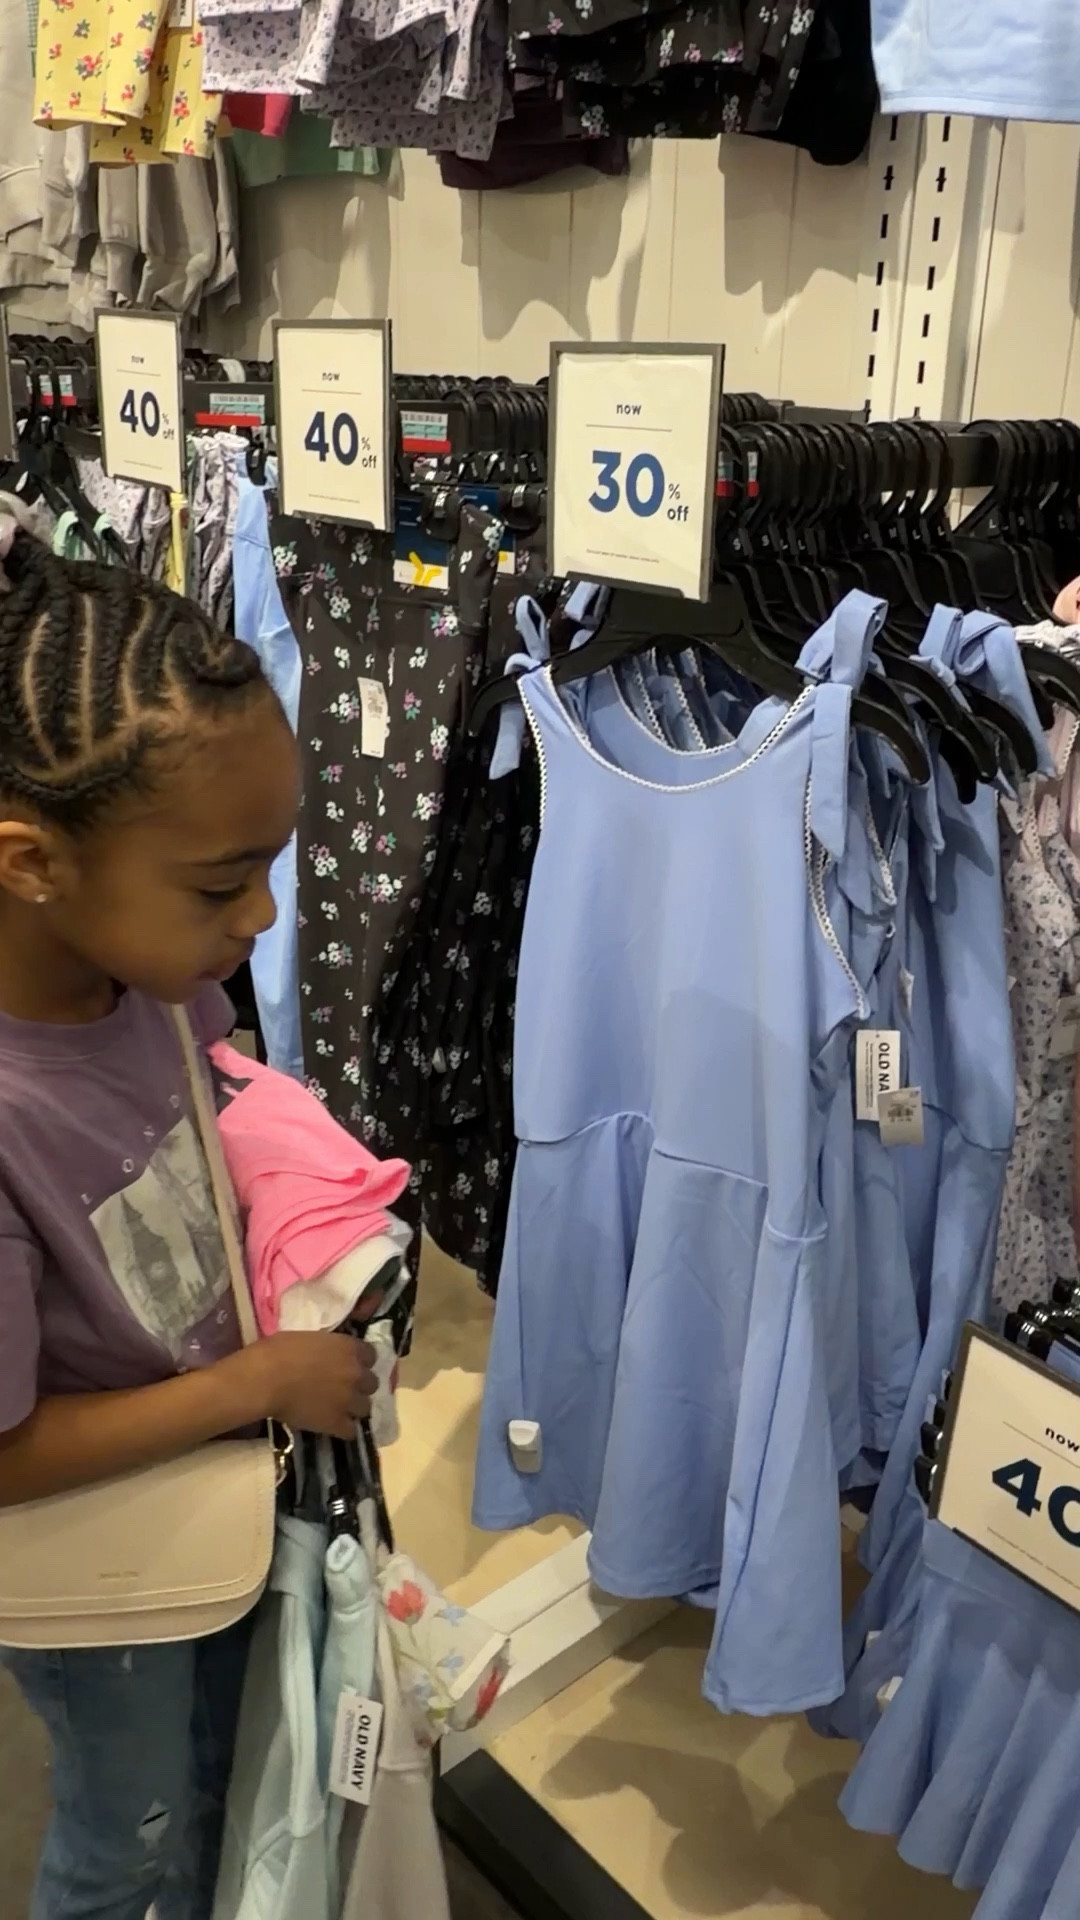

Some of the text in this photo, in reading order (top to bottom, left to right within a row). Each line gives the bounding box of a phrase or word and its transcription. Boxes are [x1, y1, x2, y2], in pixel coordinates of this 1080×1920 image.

[321, 372, 340, 381] now
[616, 403, 642, 415] now
[361, 455, 377, 468] off
[666, 505, 689, 522] off
[878, 1042, 890, 1092] OLD NA
[1045, 1427, 1080, 1453] now
[351, 1714, 372, 1791] OLD NAVY
